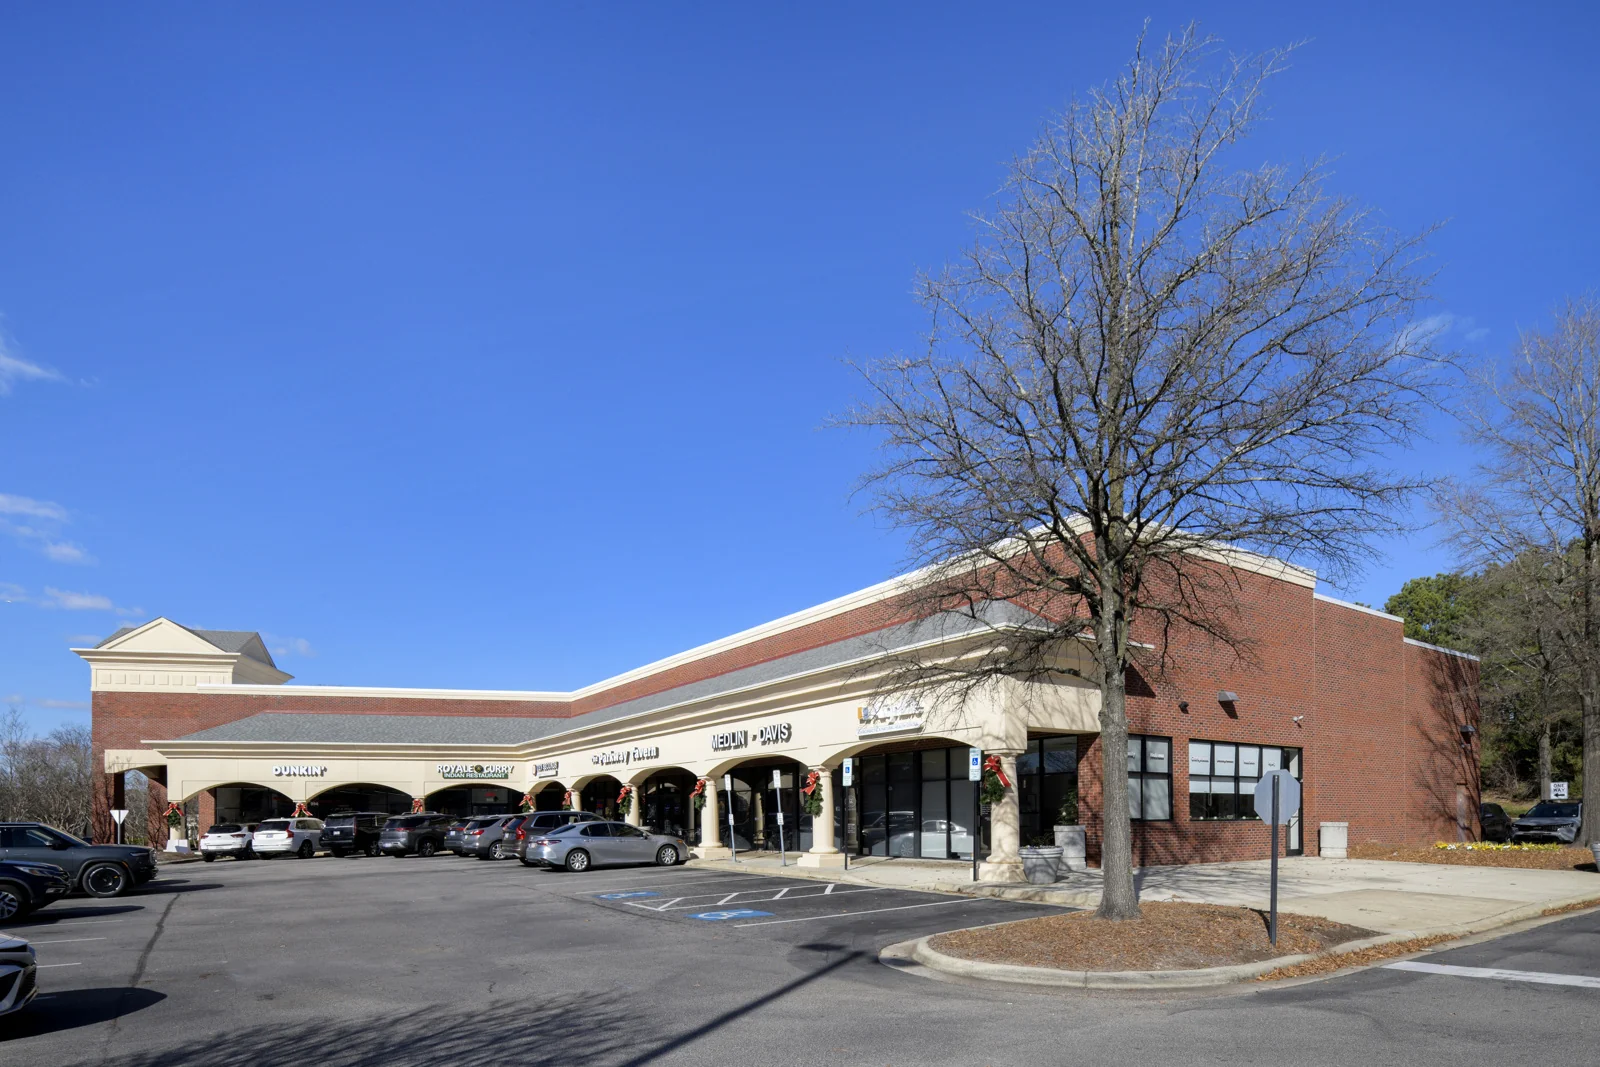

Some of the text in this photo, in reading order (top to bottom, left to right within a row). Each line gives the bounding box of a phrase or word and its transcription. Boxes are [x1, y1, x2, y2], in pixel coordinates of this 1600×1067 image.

[711, 730, 747, 750] MEDLIN
[758, 723, 791, 744] DAVIS
[272, 765, 327, 776] DUNKIN'
[436, 764, 514, 773] ROYALE CURRY
